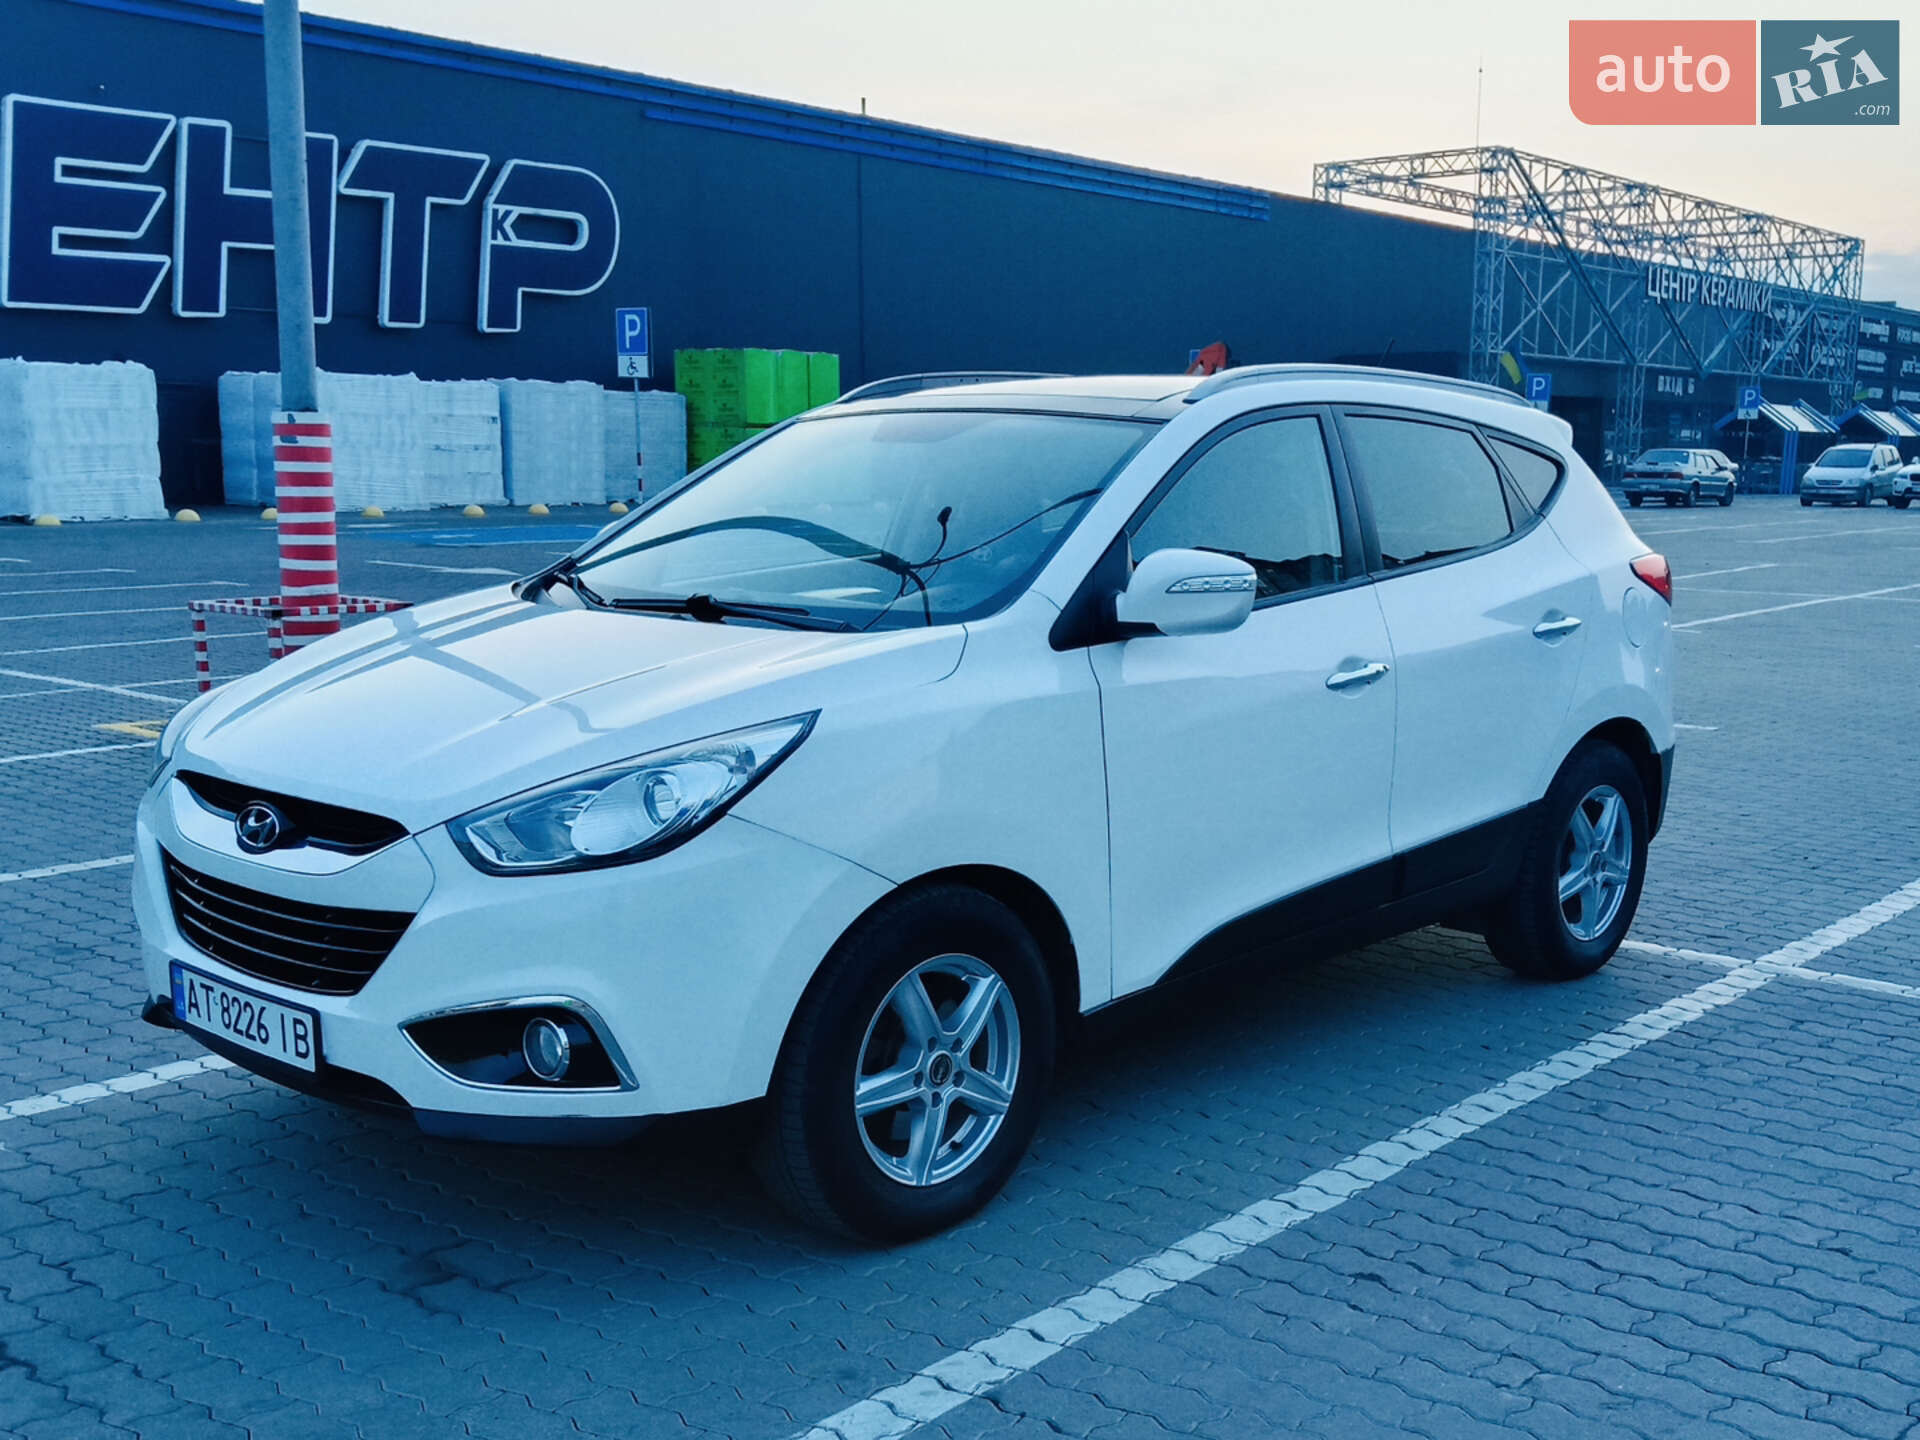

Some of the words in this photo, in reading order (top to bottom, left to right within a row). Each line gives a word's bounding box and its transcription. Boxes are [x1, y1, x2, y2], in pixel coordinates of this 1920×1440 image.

[1647, 265, 1697, 304] ЦЕНТР
[1701, 275, 1773, 318] КЕРАМІКИ
[625, 314, 640, 349] P
[1532, 377, 1546, 397] P
[1744, 389, 1756, 406] P
[188, 978, 215, 1023] AT
[220, 991, 270, 1045] 8226
[280, 1012, 310, 1060] IB
